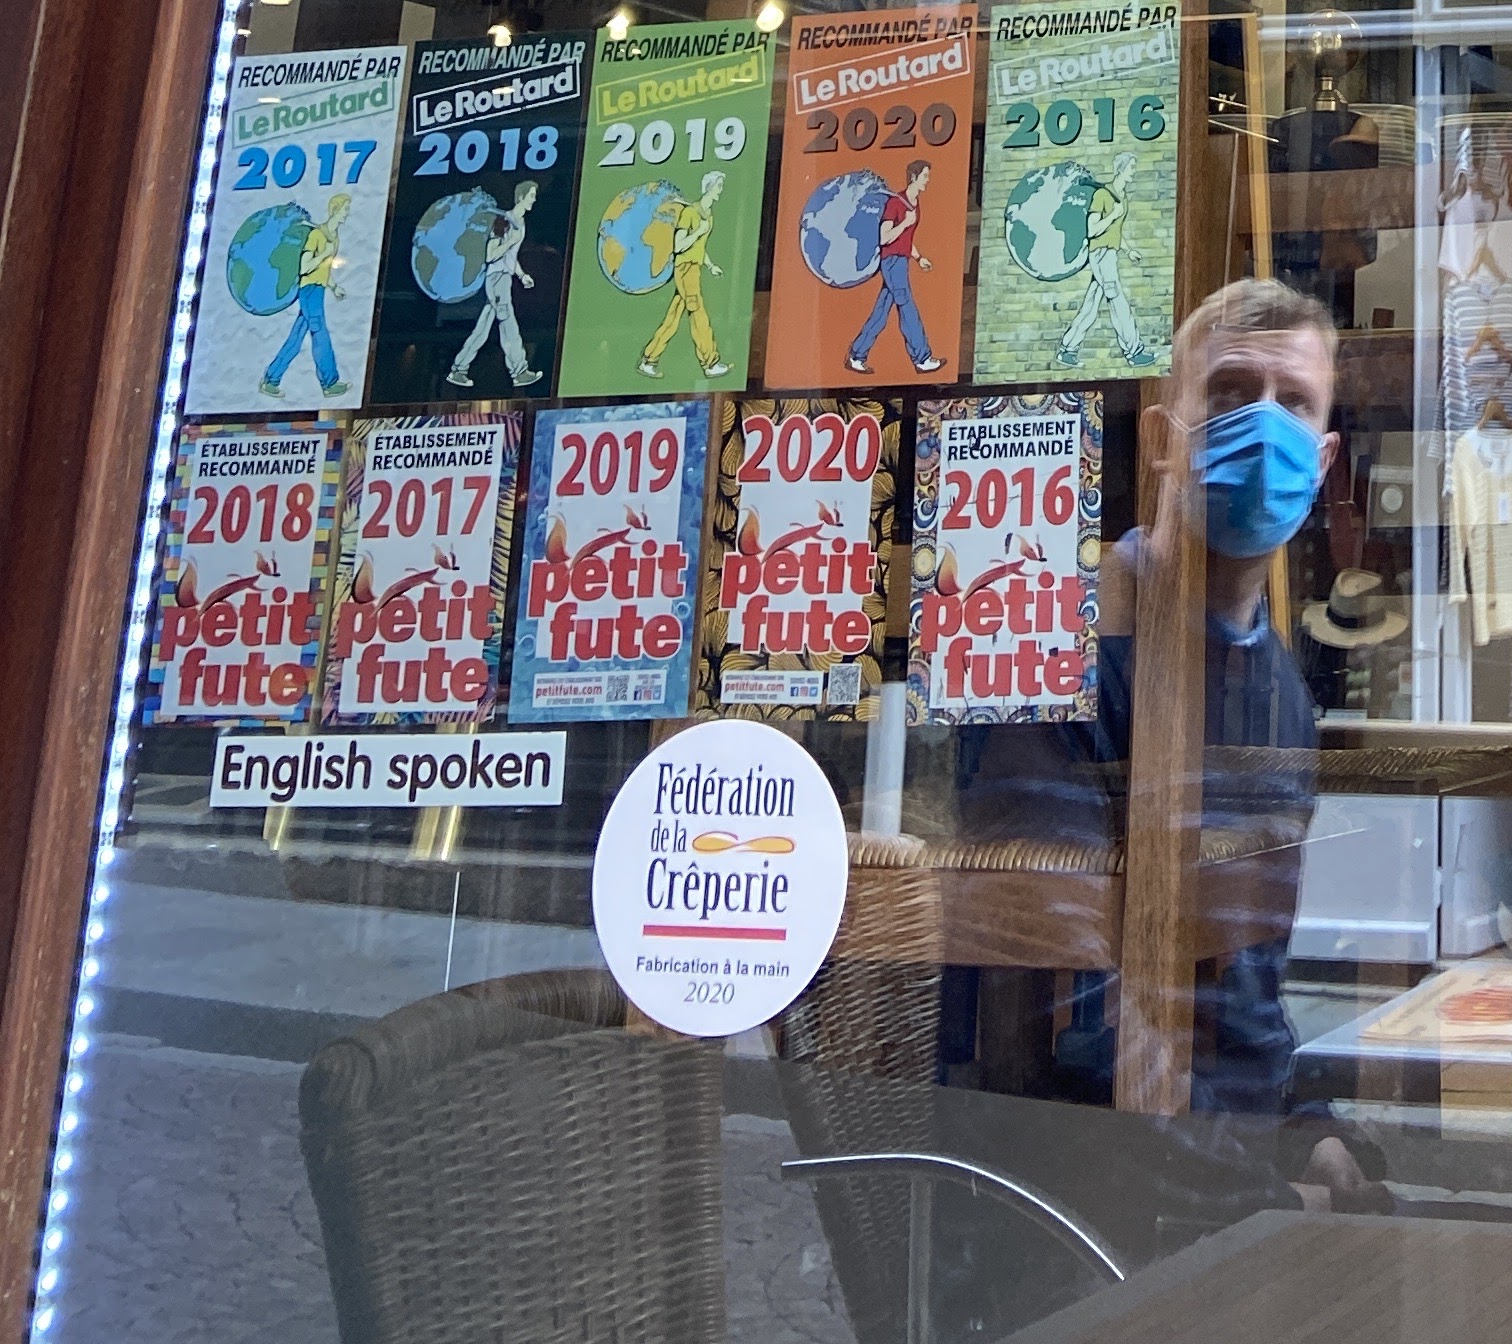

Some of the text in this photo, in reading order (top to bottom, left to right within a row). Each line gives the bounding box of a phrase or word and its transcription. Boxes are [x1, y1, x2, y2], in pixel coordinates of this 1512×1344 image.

[601, 27, 770, 62] RECOMMANDÉ PAR
[797, 13, 973, 50] RECOMMANDÉ PAR
[996, 2, 1177, 41] RECOMMANDÉ PAR
[238, 53, 401, 88] RECOMMANDÉ PAR
[418, 38, 586, 74] RECOMMANDÉ PAR
[597, 117, 747, 167] 2019
[803, 103, 957, 154] 2020
[1002, 94, 1166, 149] 2016
[233, 140, 377, 191] 2017
[413, 125, 559, 177] 2018
[201, 439, 321, 459] ÉTABLISSEMENT
[375, 430, 498, 451] ÉTABLISSEMENT
[737, 414, 881, 483] 2020
[947, 438, 1074, 462] RECOMMANDÉ
[948, 421, 1076, 442] ÉTABLISSEMENT
[198, 458, 317, 478] RECOMMANDÉ
[372, 447, 494, 471] RECOMMANDÉ
[556, 428, 680, 497] 2019
[187, 482, 316, 545] 2018
[362, 475, 492, 539] 2017
[942, 465, 1075, 530] 2016
[528, 539, 687, 618] petit
[720, 536, 876, 609] petit
[158, 586, 318, 662] petit
[335, 579, 497, 659] petit
[920, 571, 1086, 652] petit
[220, 739, 552, 803] English spoken
[653, 763, 796, 817] Fédération
[651, 818, 687, 853] de la
[646, 857, 789, 920] Crêperie
[636, 955, 790, 977] Fabrication à la main
[683, 981, 736, 1004] 2020
